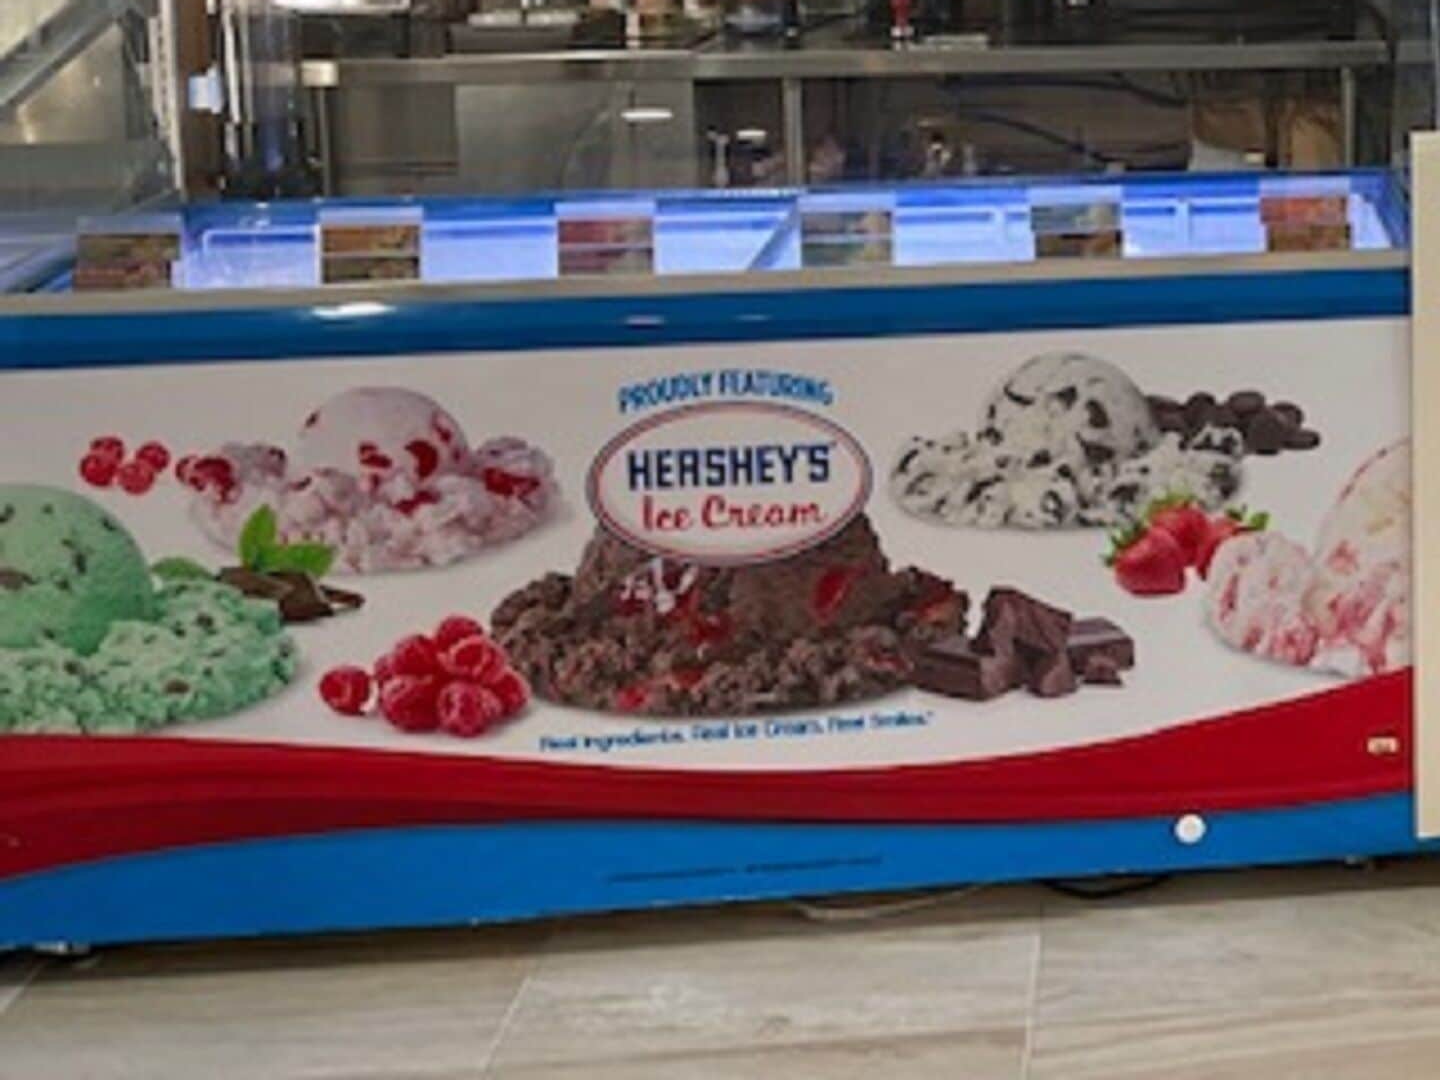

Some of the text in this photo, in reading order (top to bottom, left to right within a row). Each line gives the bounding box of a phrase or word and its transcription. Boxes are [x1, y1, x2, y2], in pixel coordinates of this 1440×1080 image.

[618, 369, 834, 412] PROUDLY FEATURING
[627, 443, 830, 490] HERSHEY'S
[642, 494, 821, 531] Ice Cream
